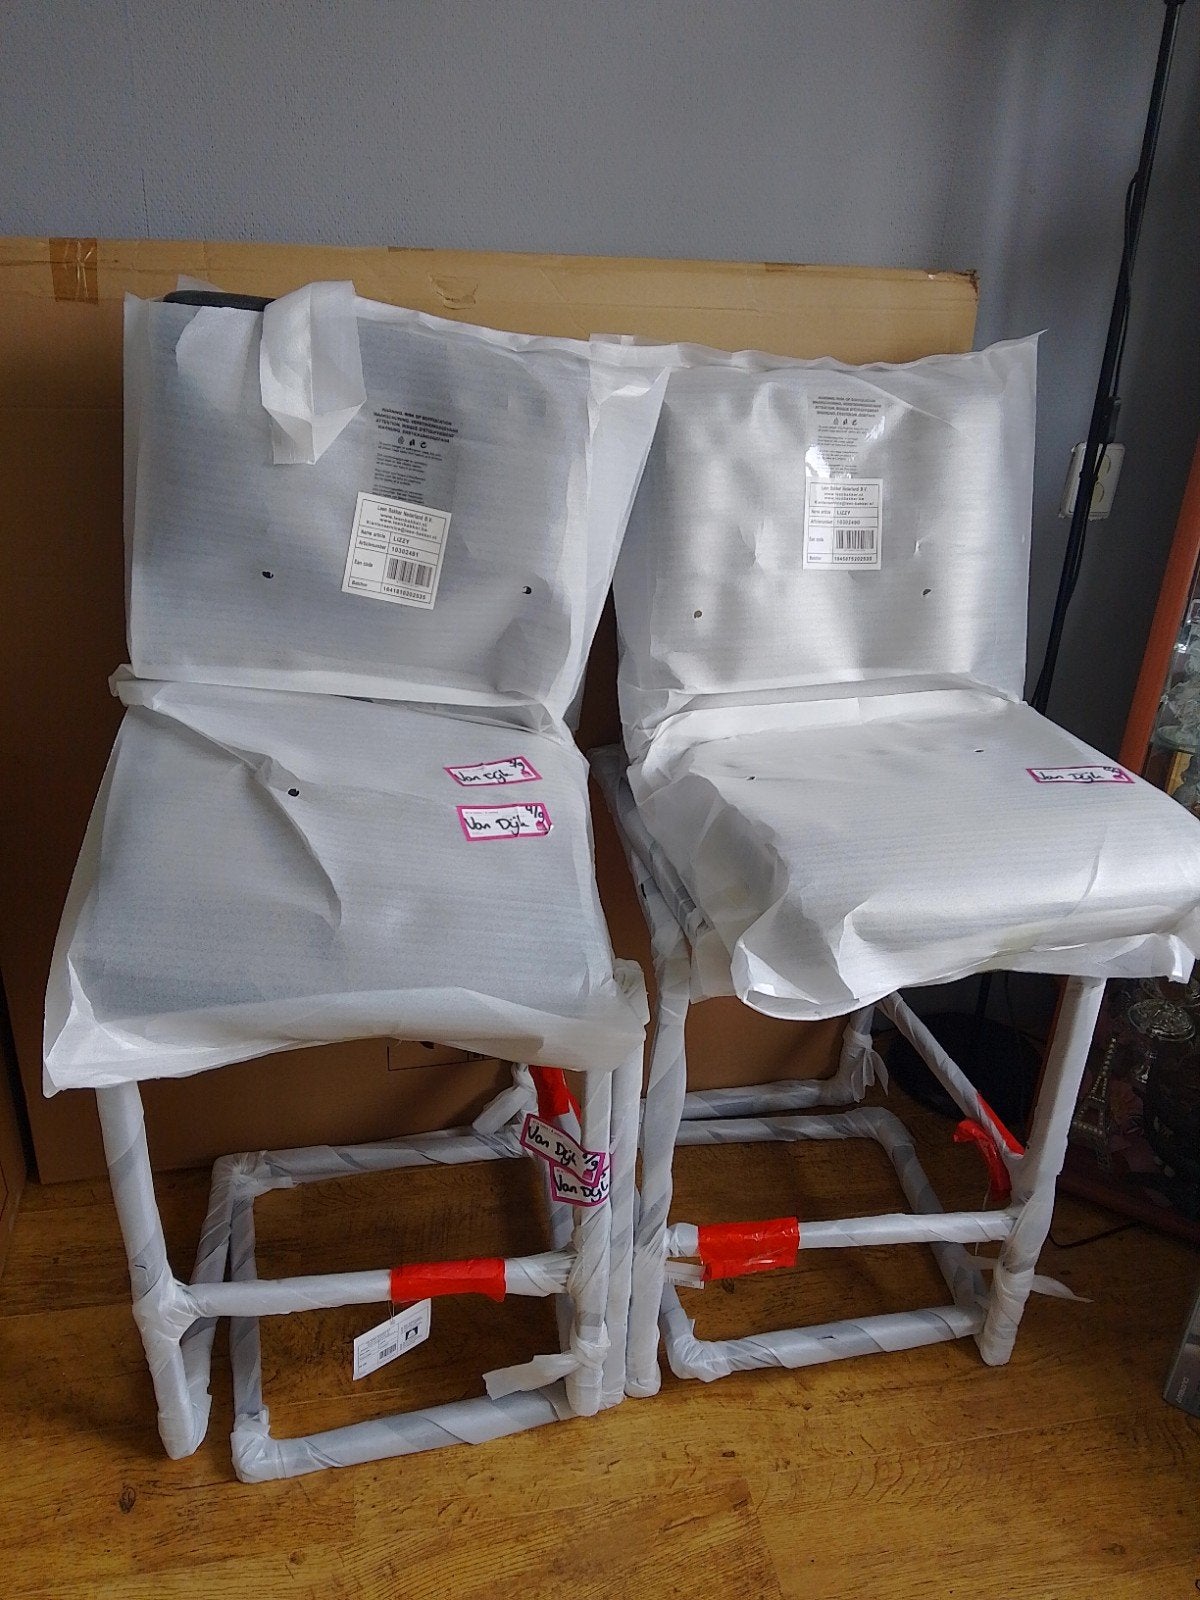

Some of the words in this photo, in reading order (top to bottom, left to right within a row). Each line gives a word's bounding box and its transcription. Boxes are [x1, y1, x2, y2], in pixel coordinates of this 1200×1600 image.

[455, 772, 481, 782] Van
[464, 817, 491, 830] Van
[528, 1126, 549, 1148] Van
[557, 1175, 577, 1194] Van
